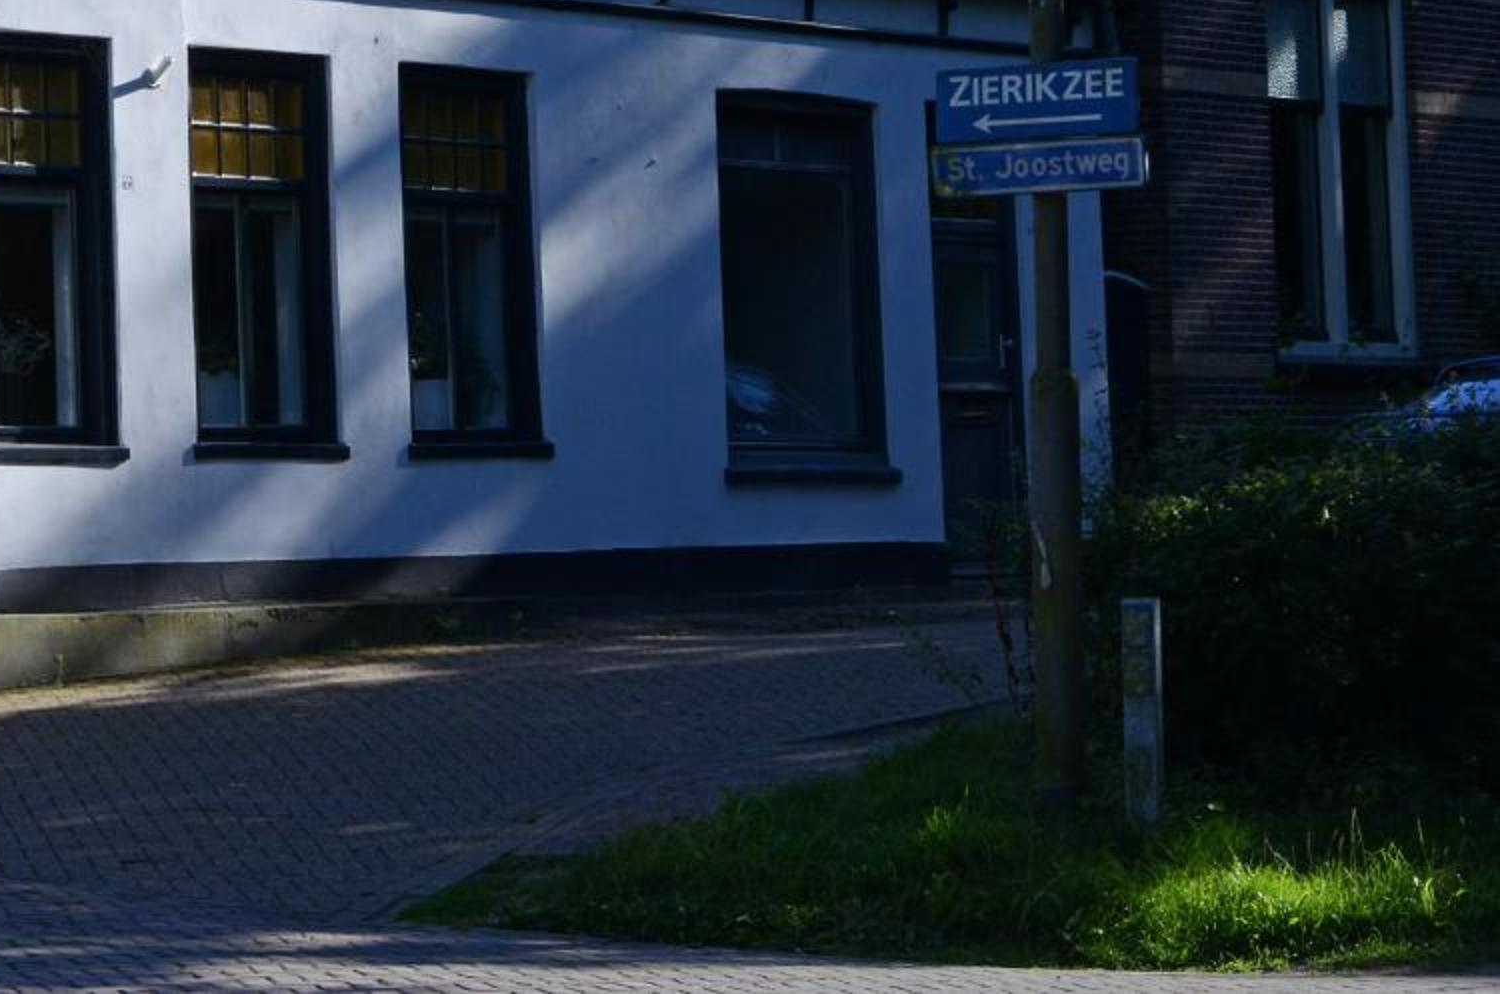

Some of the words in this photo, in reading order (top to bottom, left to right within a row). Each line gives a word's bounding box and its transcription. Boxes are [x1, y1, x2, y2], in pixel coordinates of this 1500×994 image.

[949, 68, 1124, 107] ZIERIKZEE
[948, 157, 984, 181] St.
[995, 152, 1129, 180] Joostweg
